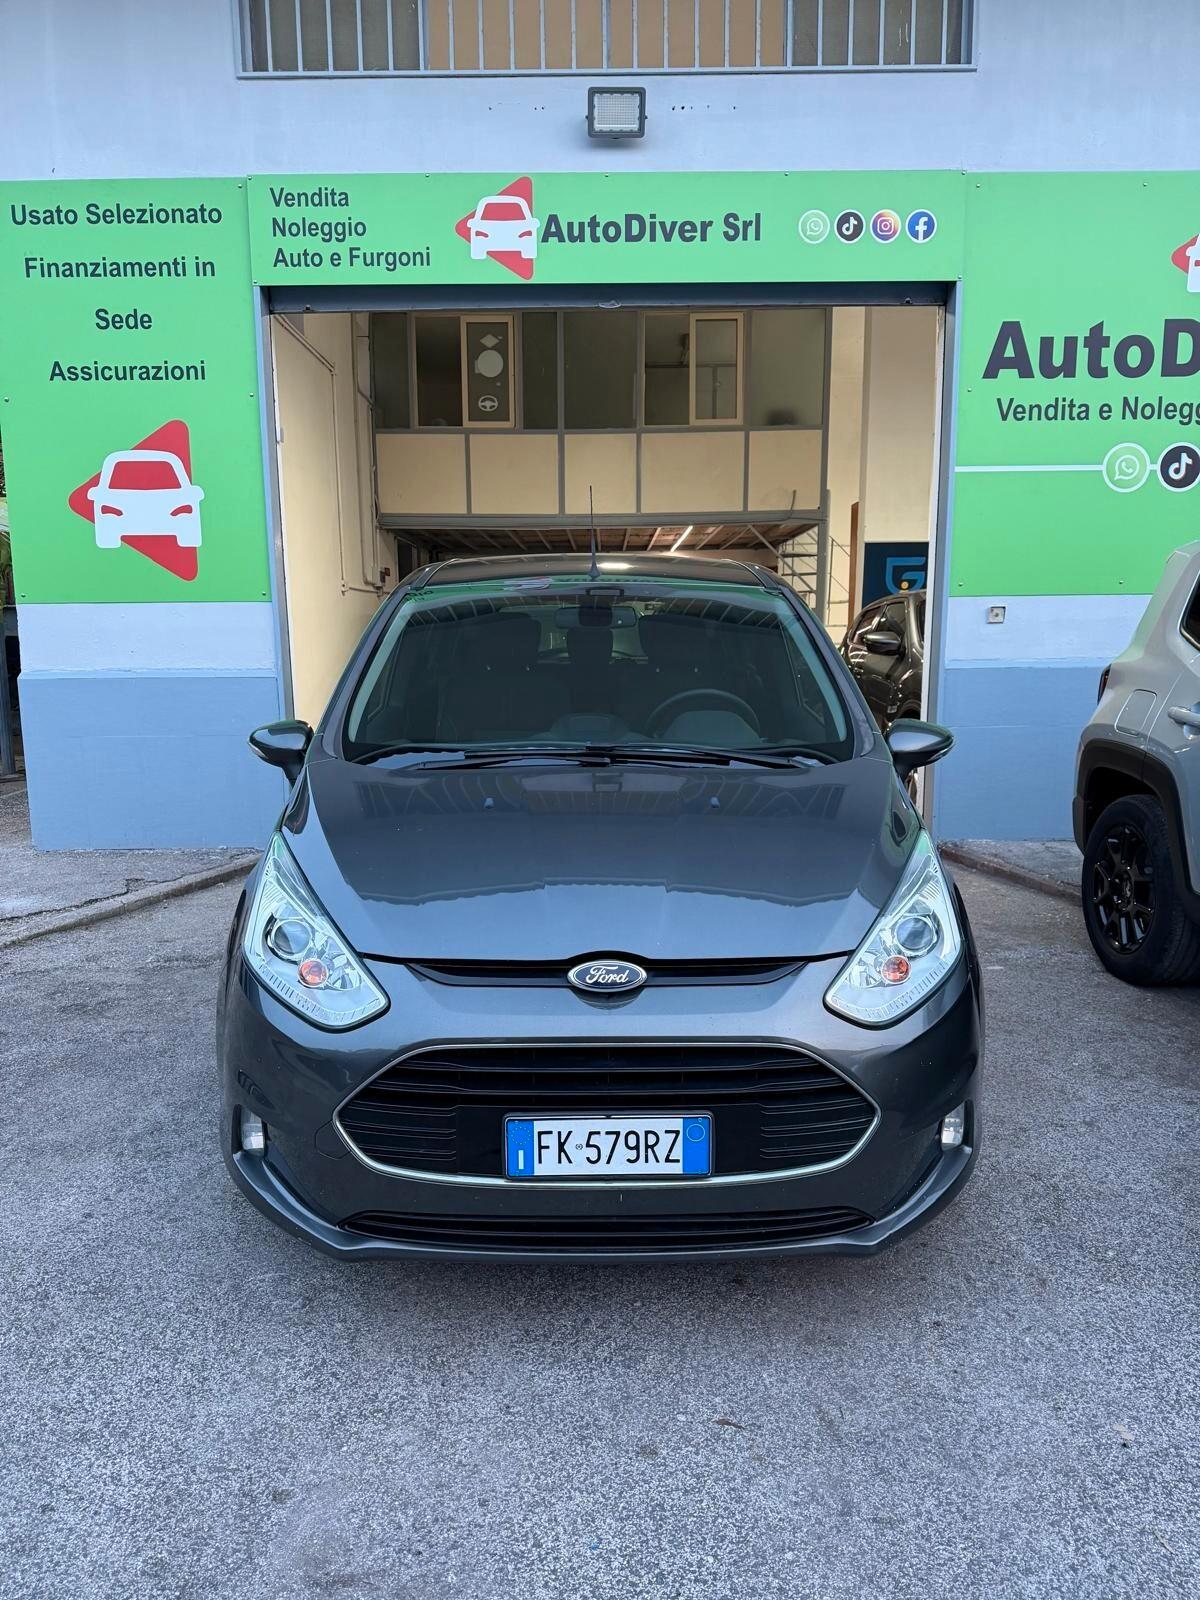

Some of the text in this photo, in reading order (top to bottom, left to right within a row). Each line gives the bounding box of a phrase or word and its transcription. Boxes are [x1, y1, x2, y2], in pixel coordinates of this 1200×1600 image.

[269, 187, 350, 207] Vendita
[10, 202, 223, 226] Usato Selezionato
[271, 217, 367, 243] Noleggio
[541, 212, 762, 243] AutoDiver Srl
[24, 256, 216, 278] Finanziamenti in
[273, 247, 431, 272] Auto e Furgoni
[95, 308, 153, 330] Sede
[49, 360, 206, 382] Assicurazioni
[996, 397, 1090, 422] Vendita
[1098, 402, 1113, 421] e
[585, 965, 630, 984] Ford
